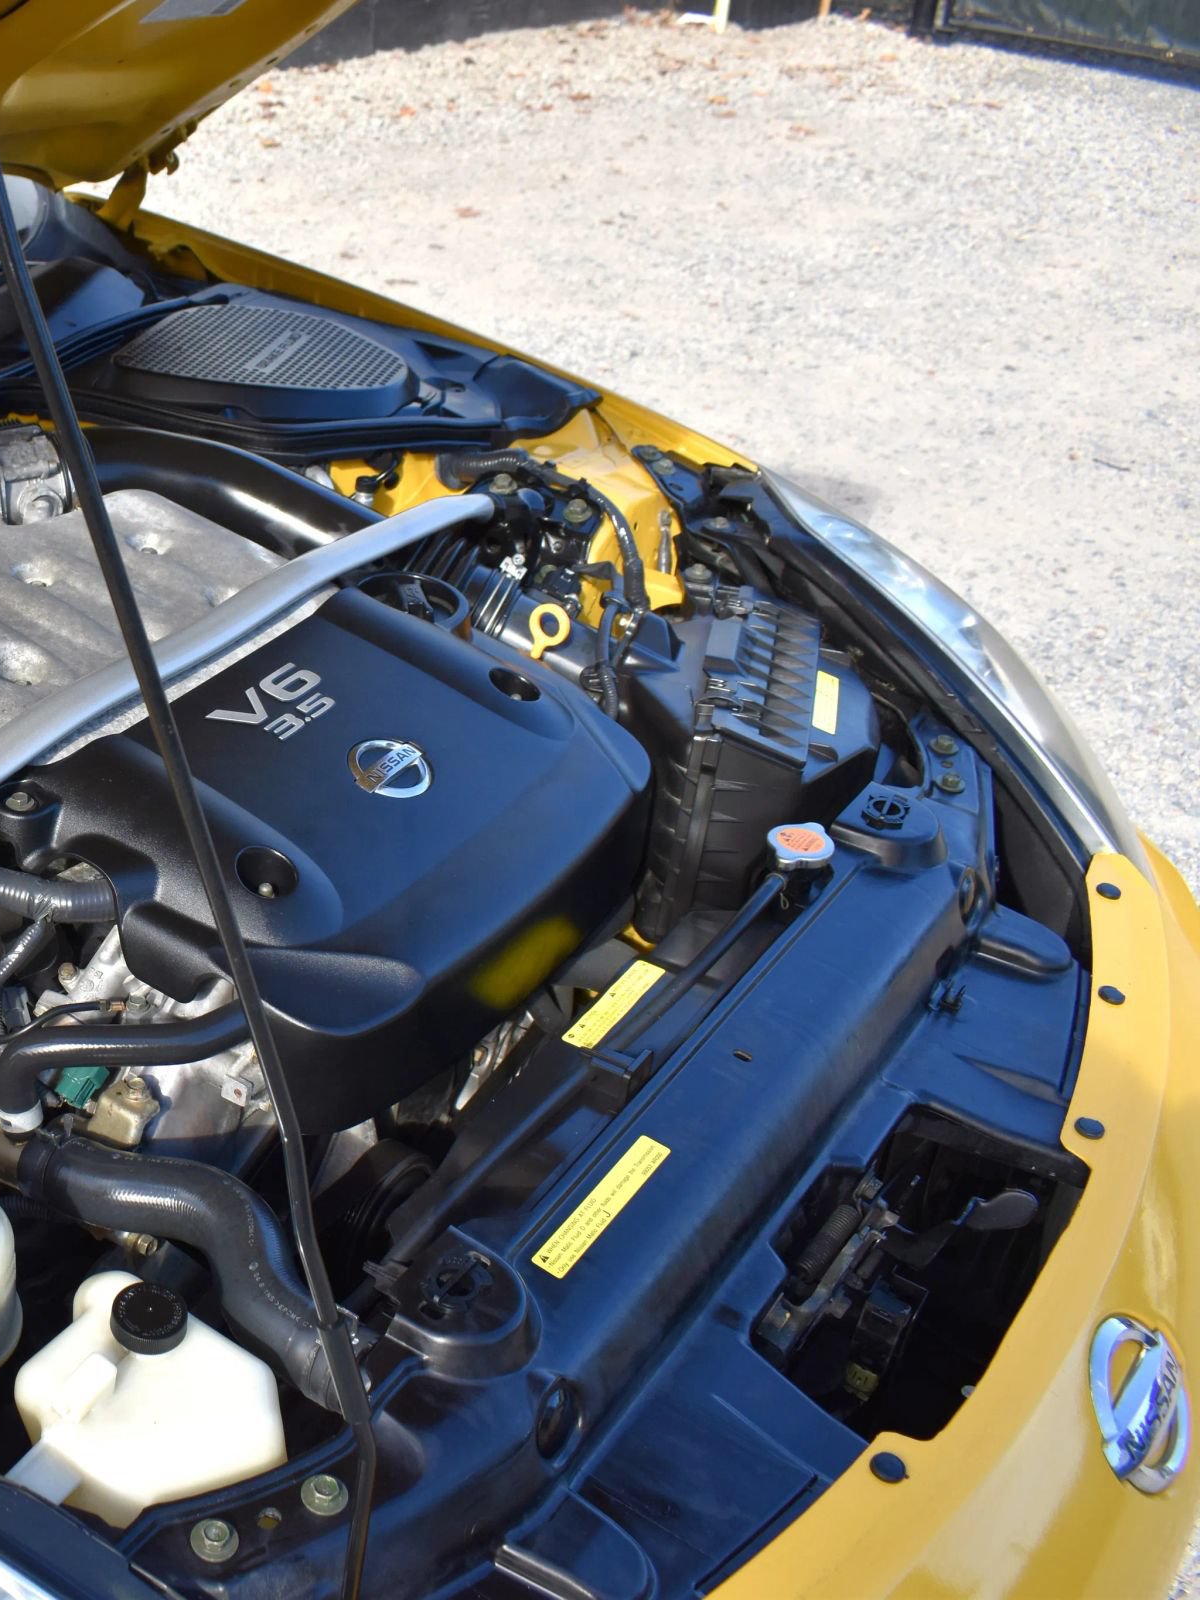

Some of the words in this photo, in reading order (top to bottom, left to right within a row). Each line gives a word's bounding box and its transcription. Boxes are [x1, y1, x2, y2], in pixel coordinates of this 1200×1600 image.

[205, 662, 321, 724] V6
[263, 692, 335, 740] 3.5
[366, 746, 417, 783] NISSAN
[600, 1209, 611, 1218] J
[1122, 1350, 1178, 1461] NISSAN
